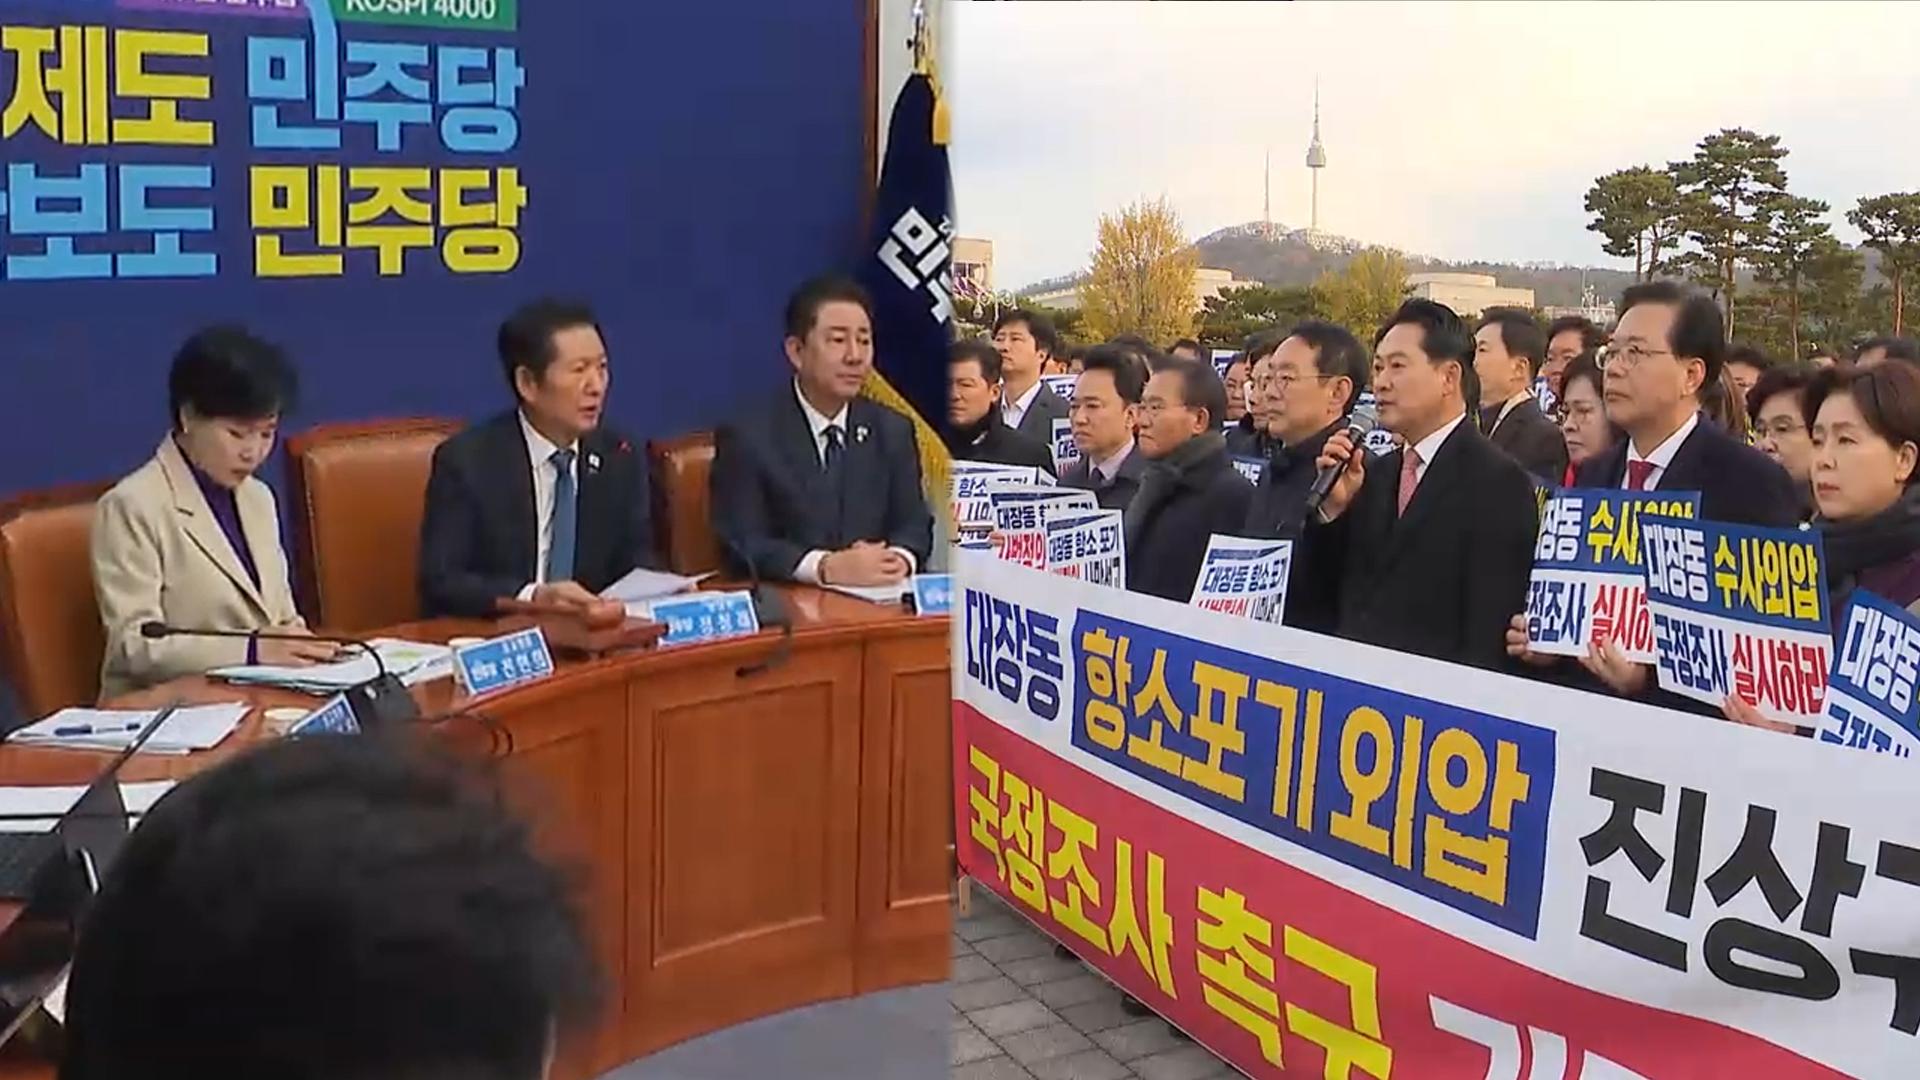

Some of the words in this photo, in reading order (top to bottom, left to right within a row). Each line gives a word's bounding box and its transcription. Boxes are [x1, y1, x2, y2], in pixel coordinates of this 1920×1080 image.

[246, 36, 526, 152] 민주당
[0, 163, 218, 279] 보도
[250, 165, 528, 276] 민주당
[997, 505, 1036, 529] 대장동
[1049, 534, 1073, 563] 대장동
[1075, 529, 1098, 558] 항소
[1100, 523, 1120, 553] 포기
[1534, 498, 1584, 561] 장동
[1202, 565, 1250, 592] 대장동
[1526, 580, 1587, 645] 정조사
[1643, 524, 1709, 602] 대장동
[1714, 535, 1821, 621] 수사외압
[1654, 613, 1729, 697] 국정조사
[1733, 633, 1829, 715] 실시하라
[1838, 603, 1920, 715] 대장동
[965, 587, 1063, 722] 대장동
[1079, 626, 1532, 908] 항소포기외압
[968, 744, 1180, 999] 국정조사
[1194, 884, 1396, 1080] 촉구
